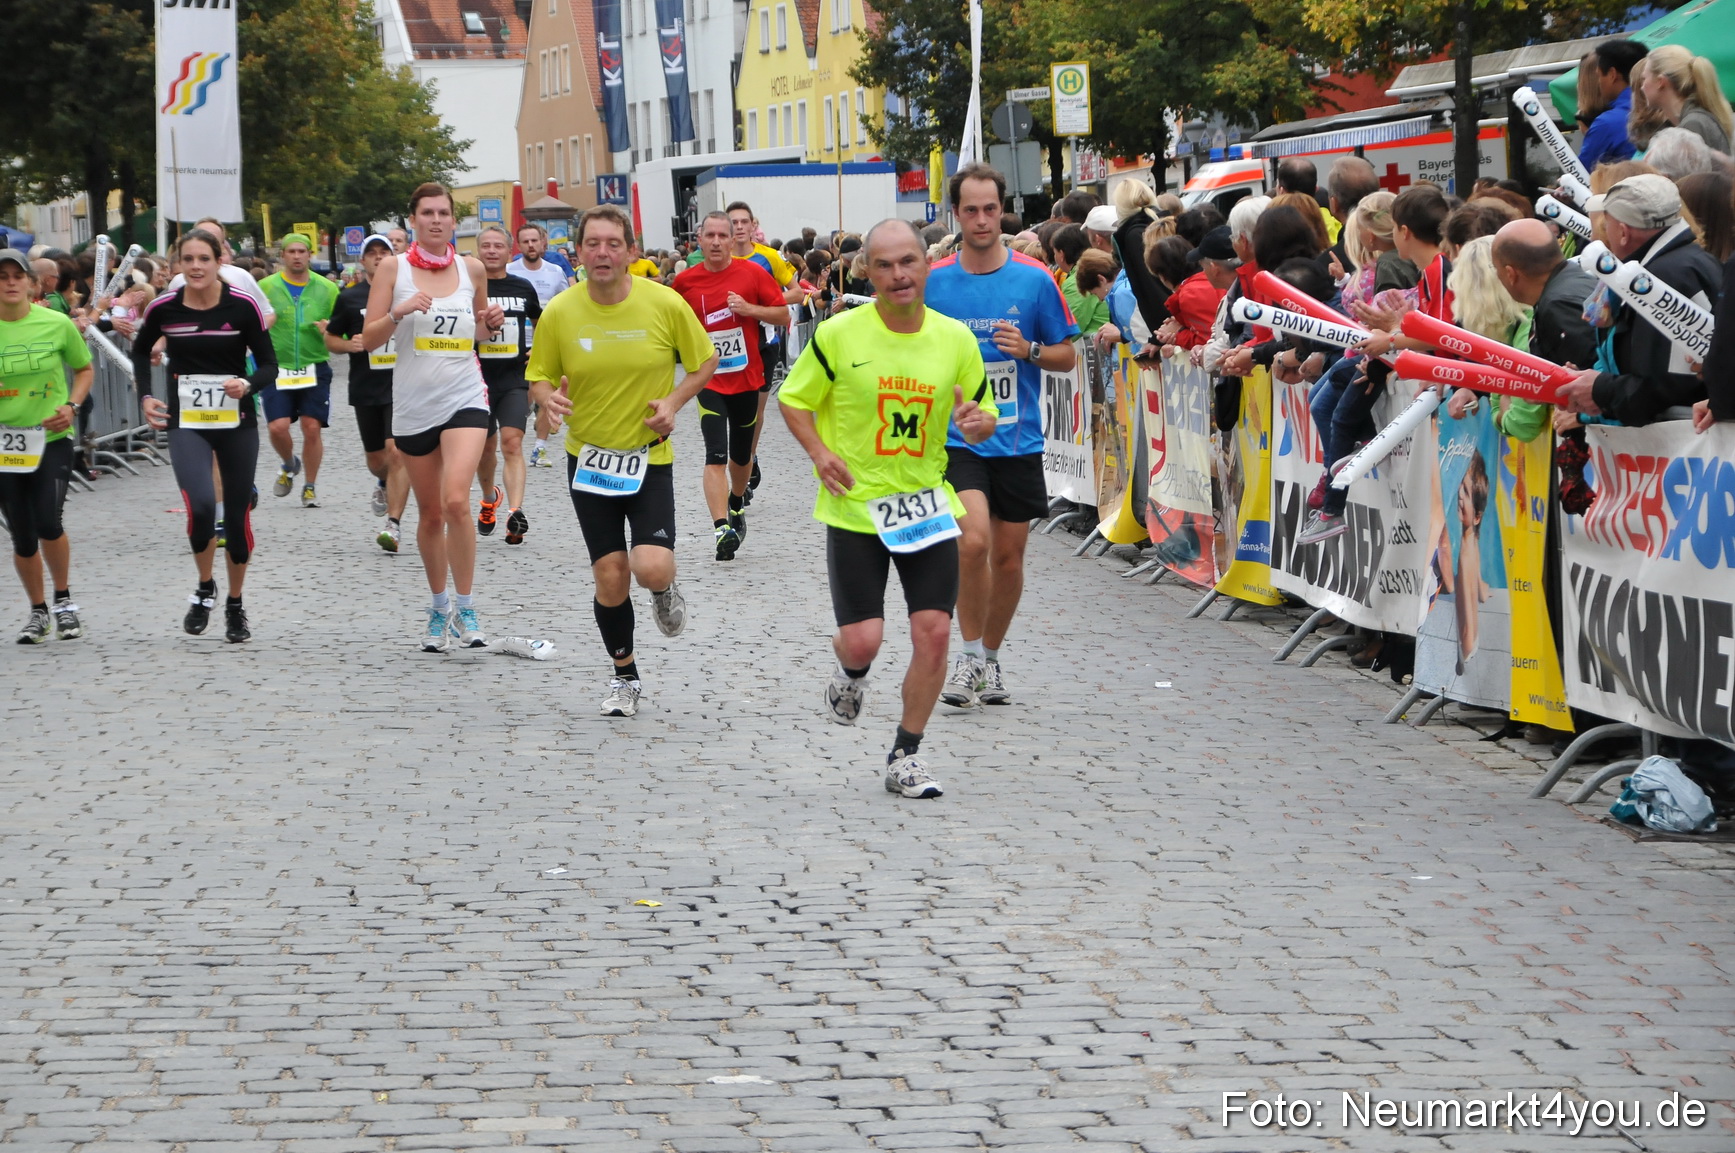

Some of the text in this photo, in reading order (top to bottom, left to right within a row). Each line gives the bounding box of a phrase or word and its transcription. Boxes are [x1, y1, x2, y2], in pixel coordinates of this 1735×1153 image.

[771, 75, 789, 97] HOTEL
[1063, 73, 1077, 89] H
[487, 297, 525, 312] HULE
[1654, 290, 1701, 328] BMW
[433, 315, 458, 335] 27
[1271, 311, 1315, 334] BMW
[429, 340, 460, 349] Sabrina
[714, 338, 742, 357] 624
[1483, 351, 1552, 383] Audi BKK
[878, 376, 936, 395] Müller
[989, 376, 1011, 401] 40
[1477, 373, 1543, 395] Audi BKK
[192, 388, 226, 407] 217
[200, 413, 219, 421] Ilona
[890, 411, 919, 439] M
[3, 432, 27, 452] 23
[4, 456, 25, 465] Petra
[585, 448, 641, 476] 2010
[590, 474, 625, 489] Manfred
[877, 488, 938, 529] 2437
[894, 521, 943, 544] Wolfgang
[1511, 656, 1539, 670] auern
